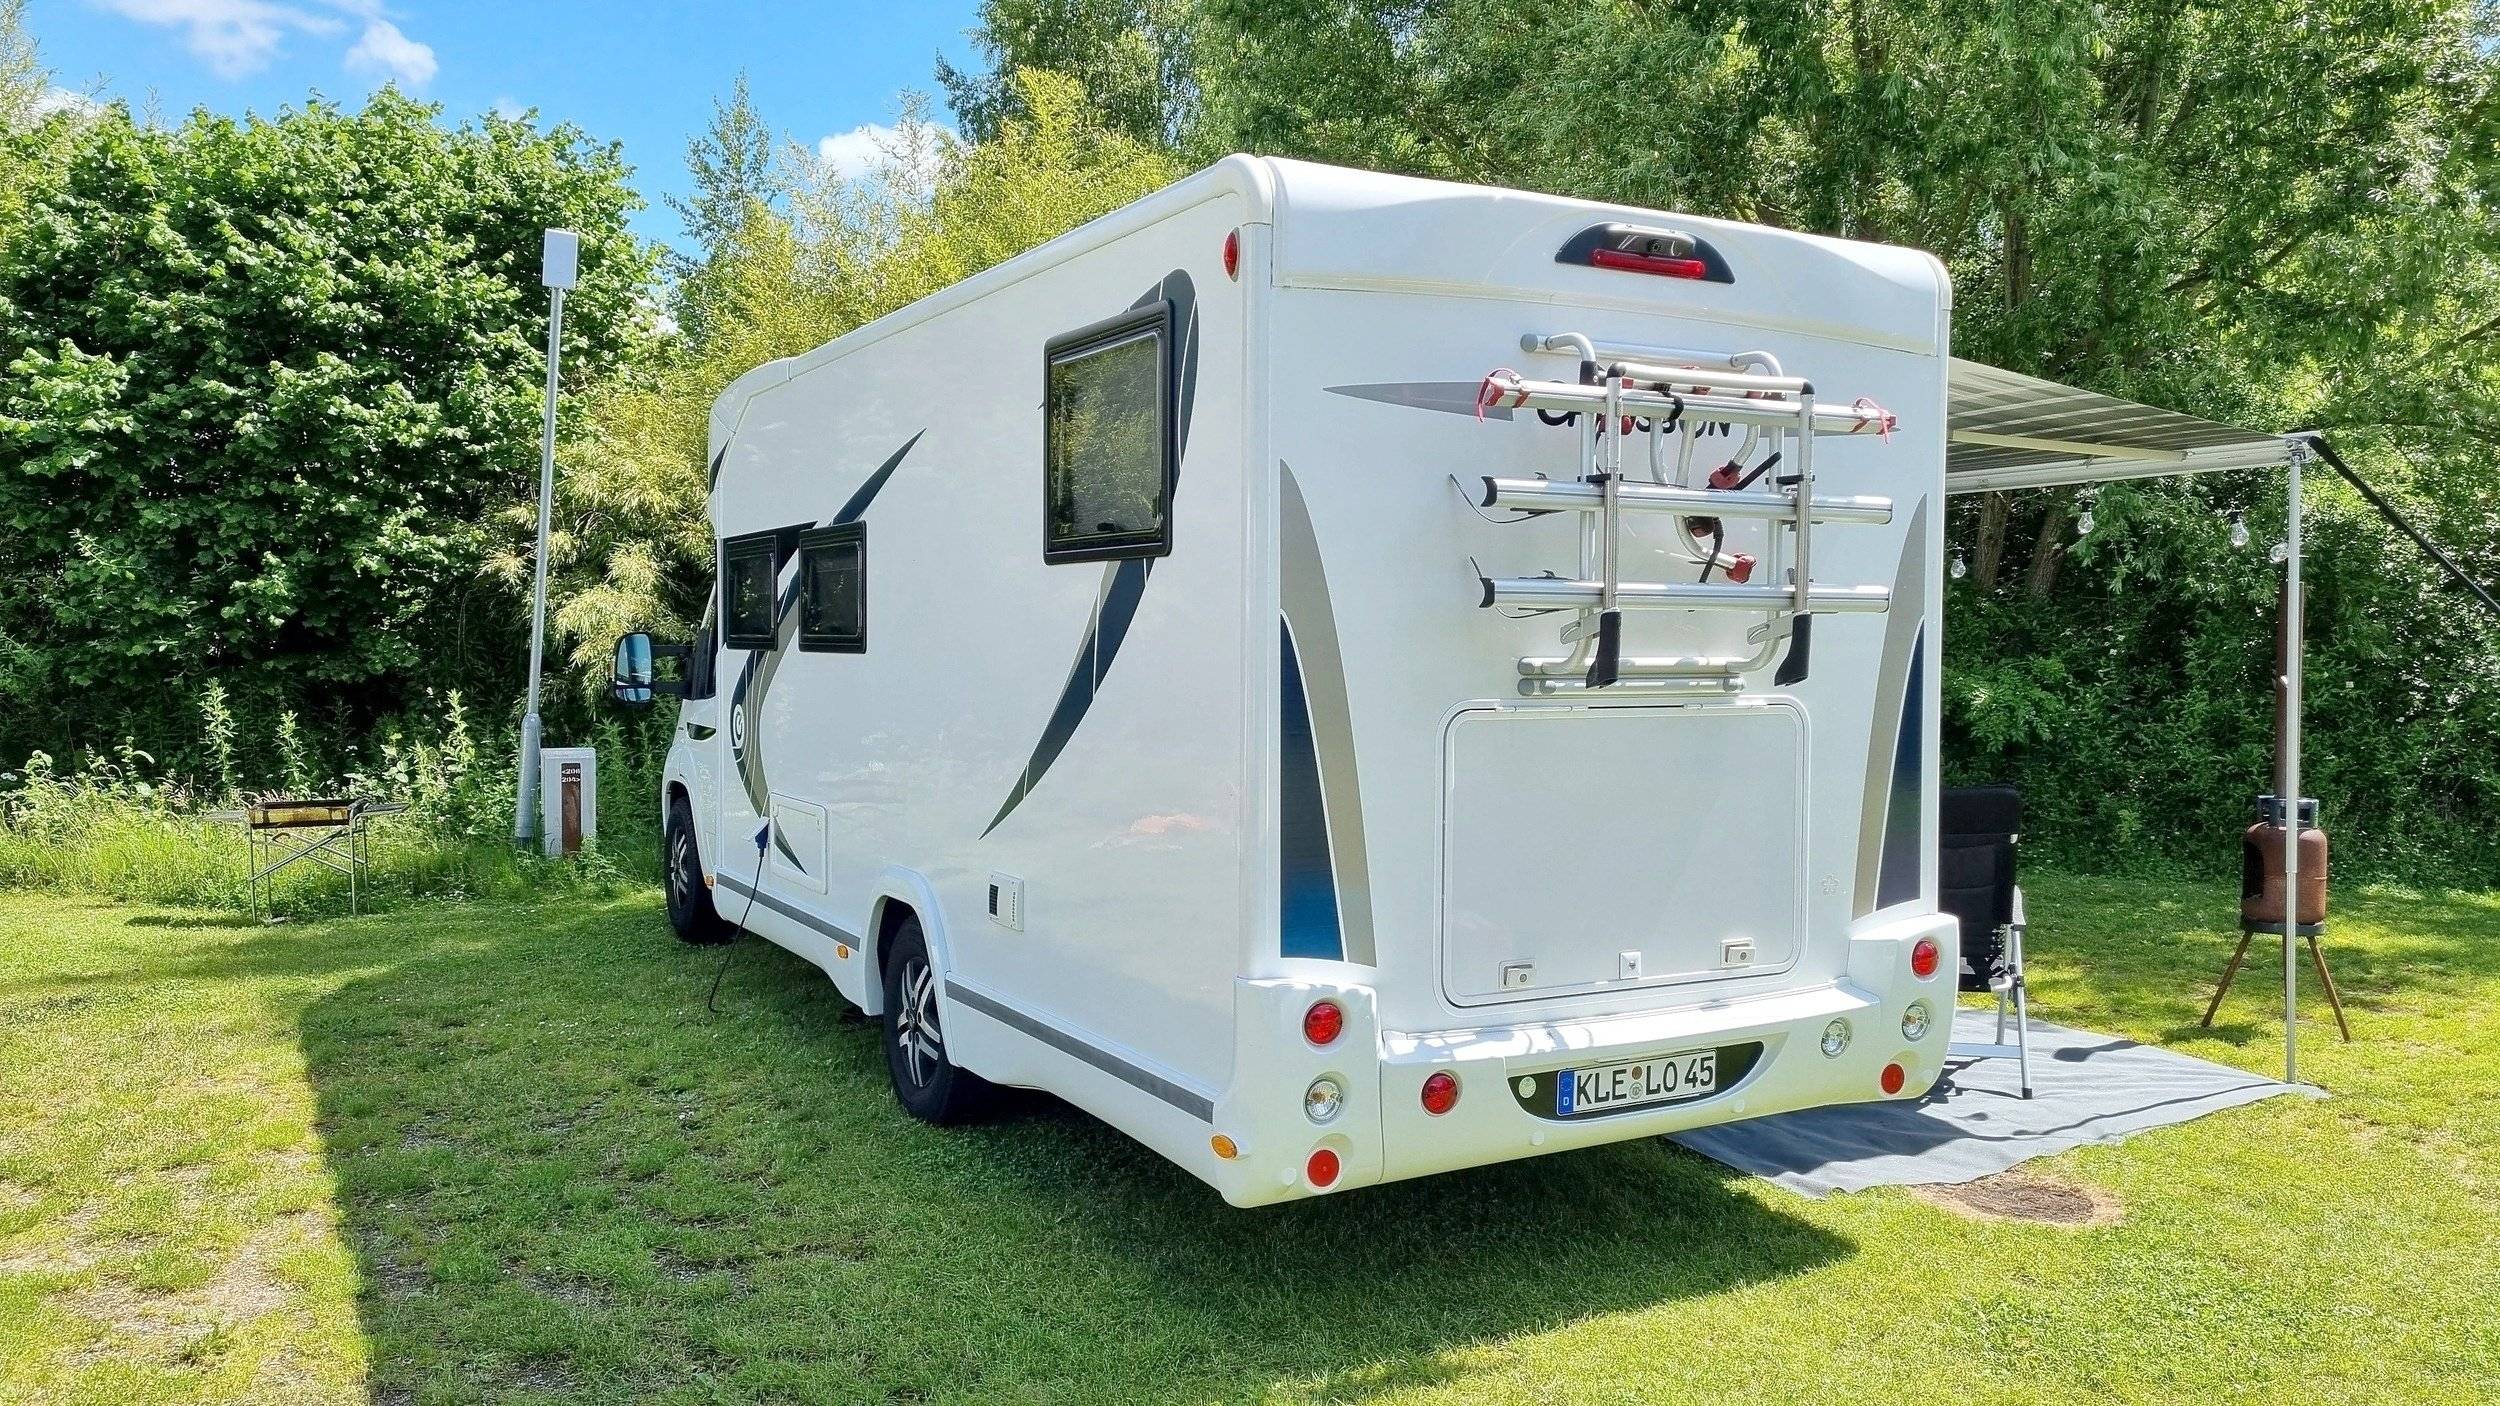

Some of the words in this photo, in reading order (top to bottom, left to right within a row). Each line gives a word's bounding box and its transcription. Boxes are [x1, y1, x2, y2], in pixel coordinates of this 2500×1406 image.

[1576, 1068, 1627, 1106] KLE
[1645, 1061, 1678, 1096] LO
[1684, 1056, 1714, 1089] 45
[1563, 1096, 1569, 1106] D
